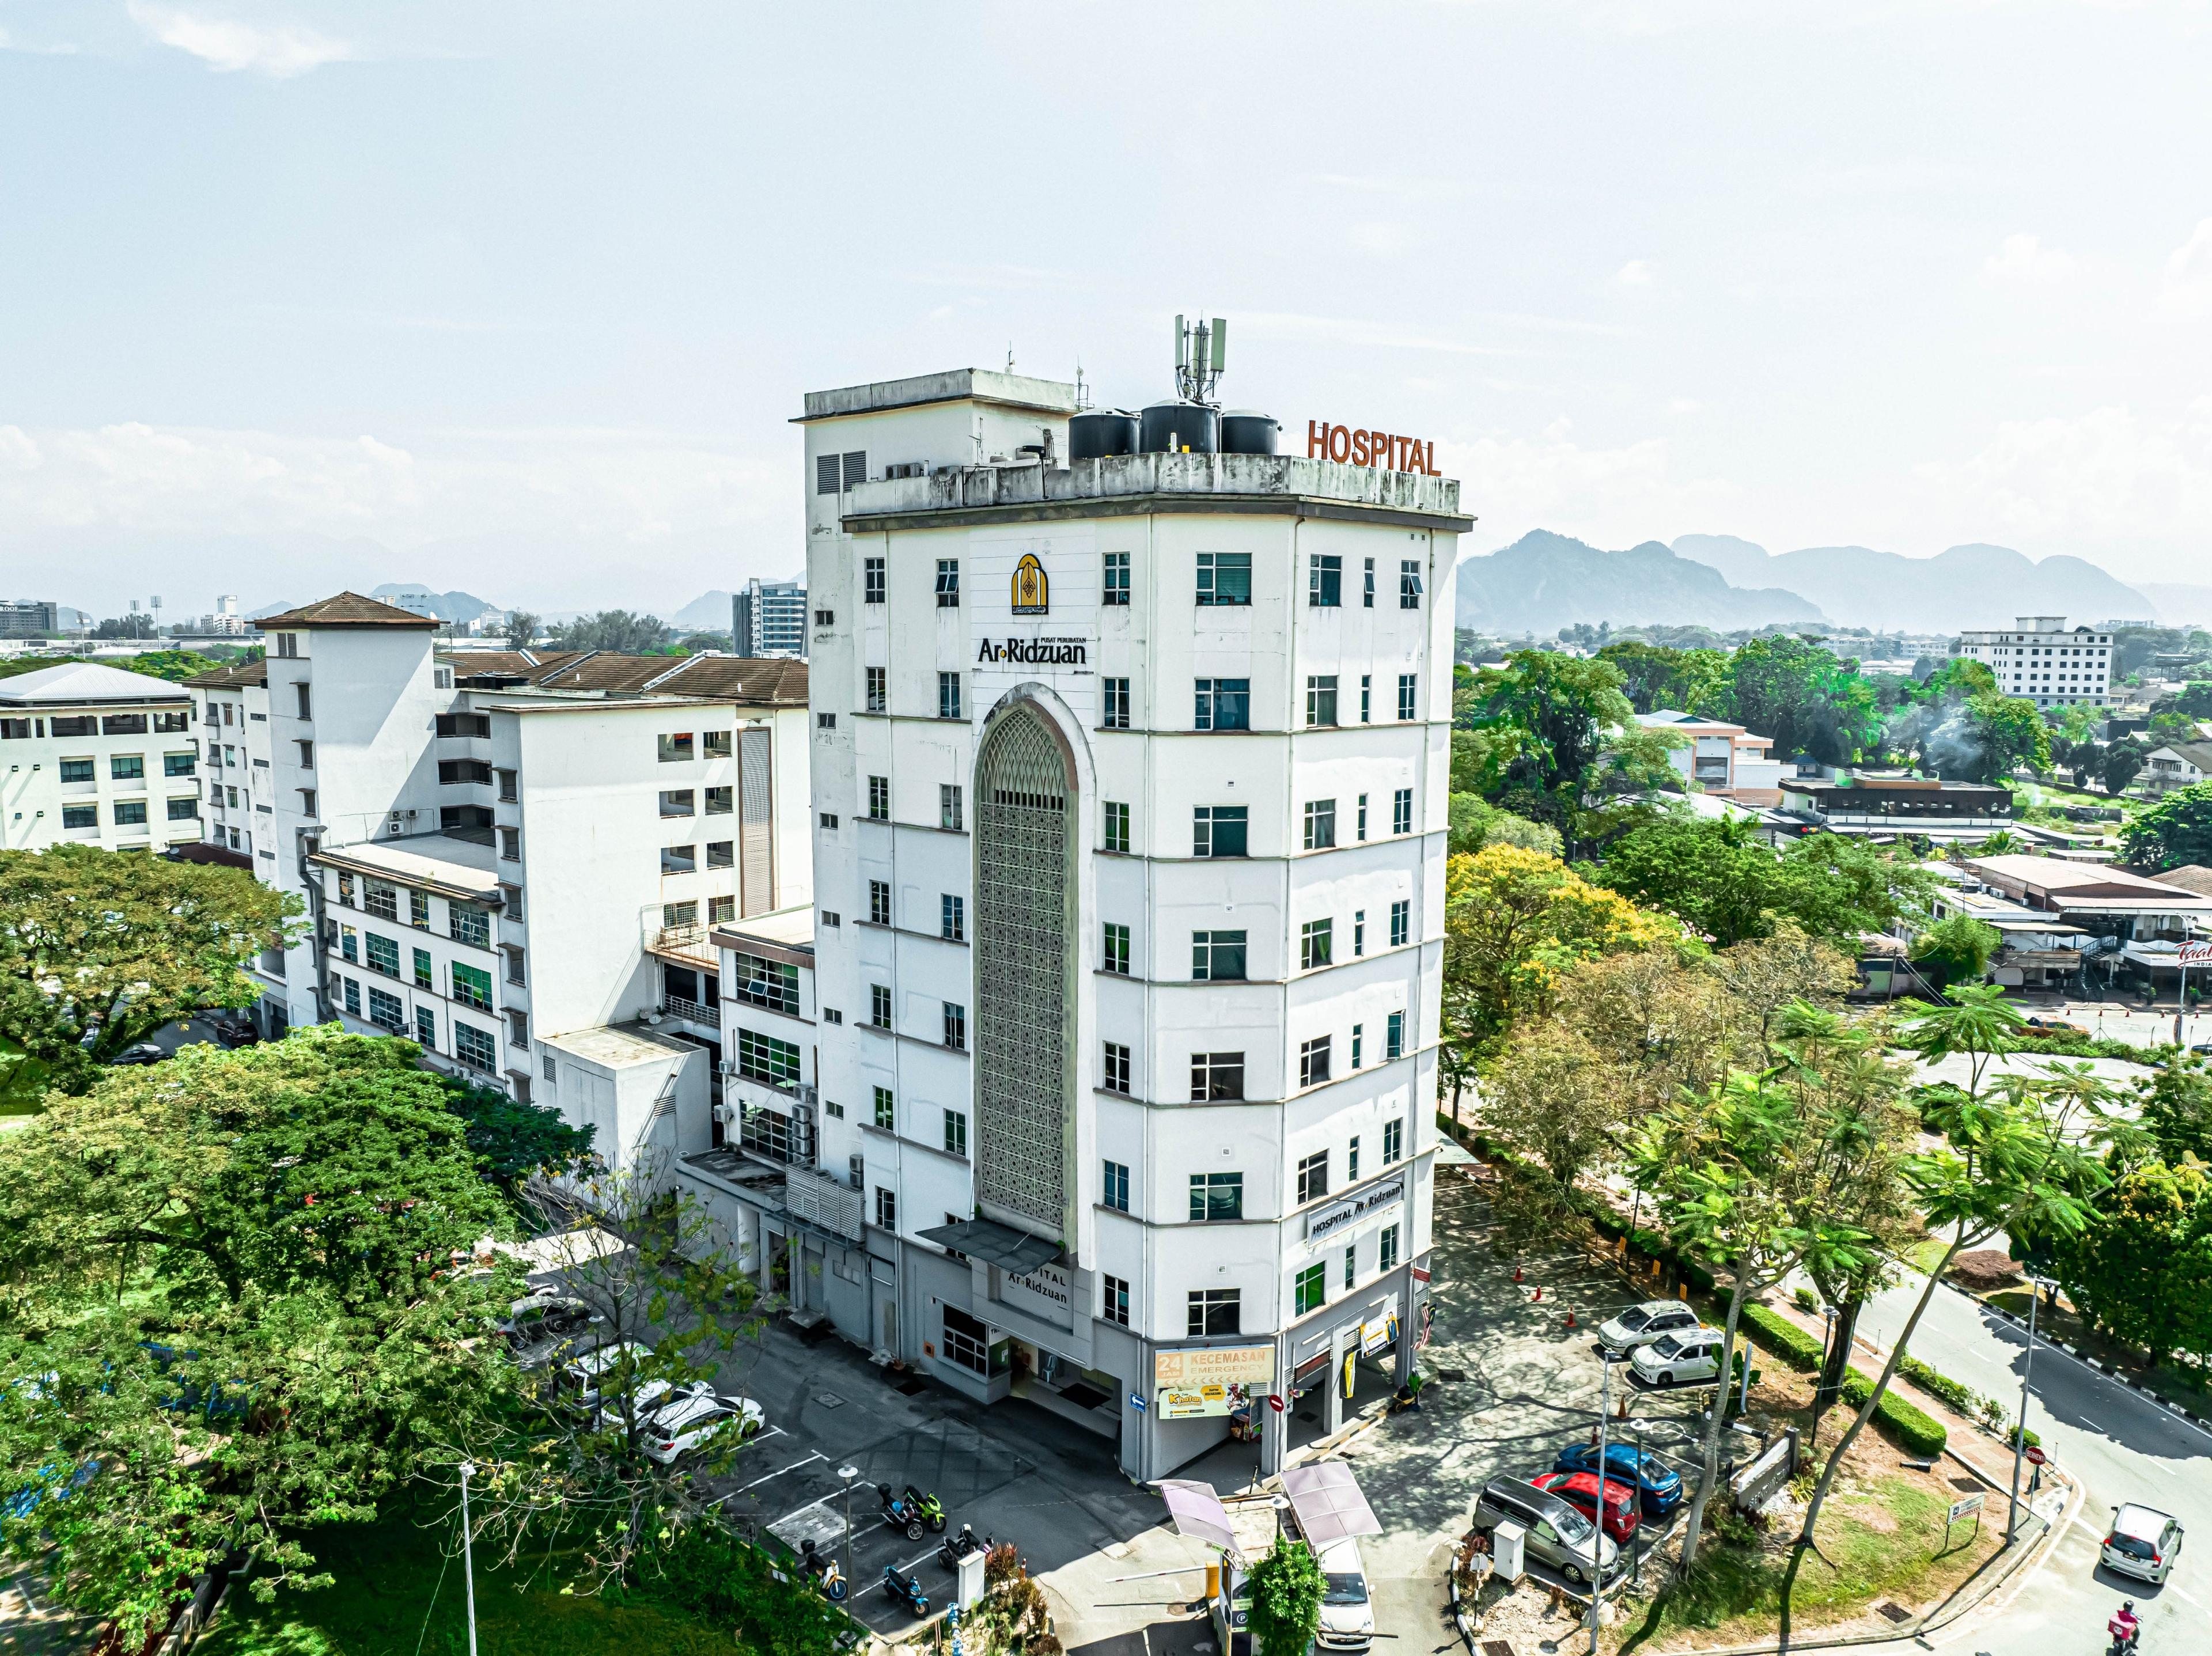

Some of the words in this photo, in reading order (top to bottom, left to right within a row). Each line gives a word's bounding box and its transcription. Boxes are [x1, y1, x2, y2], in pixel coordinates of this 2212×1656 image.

[1308, 419, 1441, 477] HOSPITAL
[1313, 1209, 1353, 1235] HOSPITAL
[1158, 1355, 1181, 1371] 24
[1191, 1351, 1266, 1365] KECEMASAN
[1191, 1364, 1264, 1374] EMERGENCY
[1168, 1393, 1202, 1404] Khatan
